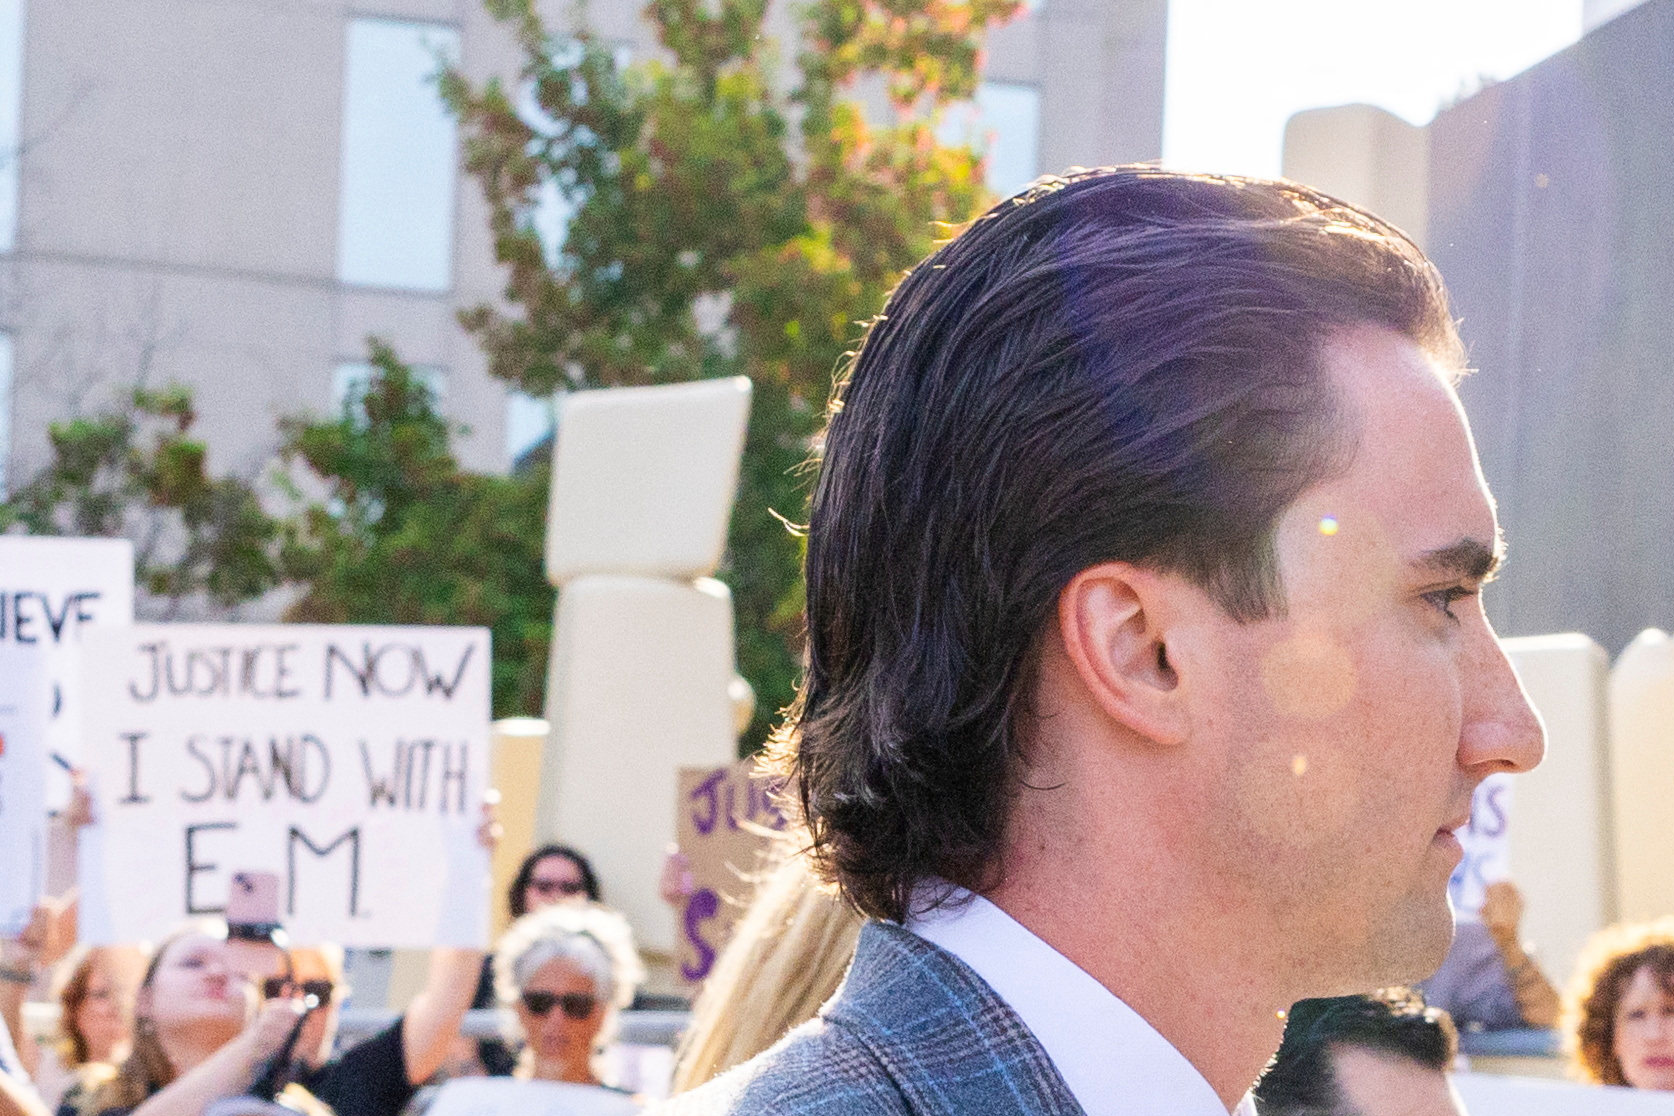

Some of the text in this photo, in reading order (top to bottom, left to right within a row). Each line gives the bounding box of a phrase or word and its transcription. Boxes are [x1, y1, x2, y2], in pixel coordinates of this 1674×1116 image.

[0, 591, 101, 643] IEVE
[128, 640, 475, 702] JUSTICE NOW
[116, 732, 151, 805] I
[180, 734, 332, 803] STAND
[359, 738, 471, 814] WITH
